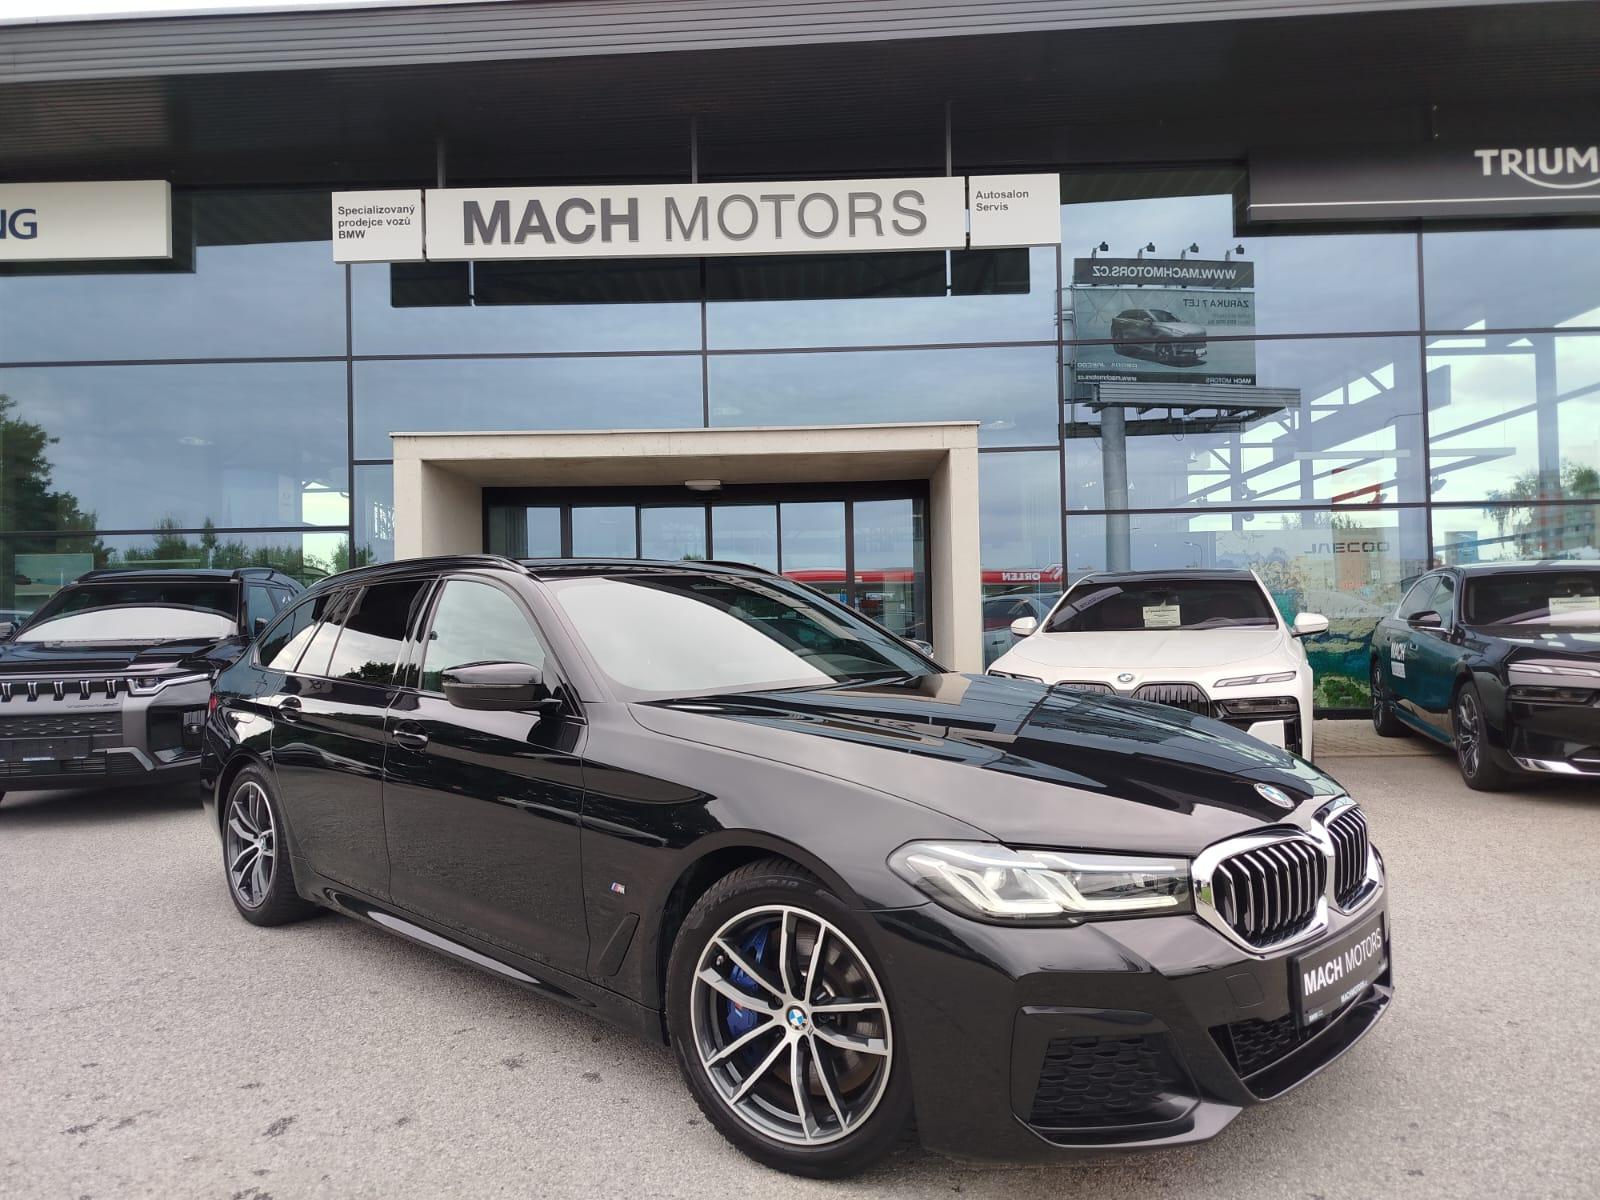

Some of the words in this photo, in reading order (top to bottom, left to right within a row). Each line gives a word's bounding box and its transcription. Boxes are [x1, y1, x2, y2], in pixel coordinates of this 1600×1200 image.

[1474, 146, 1600, 188] TRIUM
[976, 189, 1029, 199] Autosalon
[337, 204, 416, 217] Specializovaný
[976, 201, 1009, 211] Servis
[338, 217, 383, 229] prodejce
[386, 216, 411, 226] vozů
[462, 197, 640, 246] MACH
[664, 189, 929, 242] MOTORS
[338, 230, 366, 239] BMW
[1304, 542, 1390, 553] JAECOO
[1303, 956, 1343, 996] MACH
[1344, 927, 1382, 973] MOTORS
